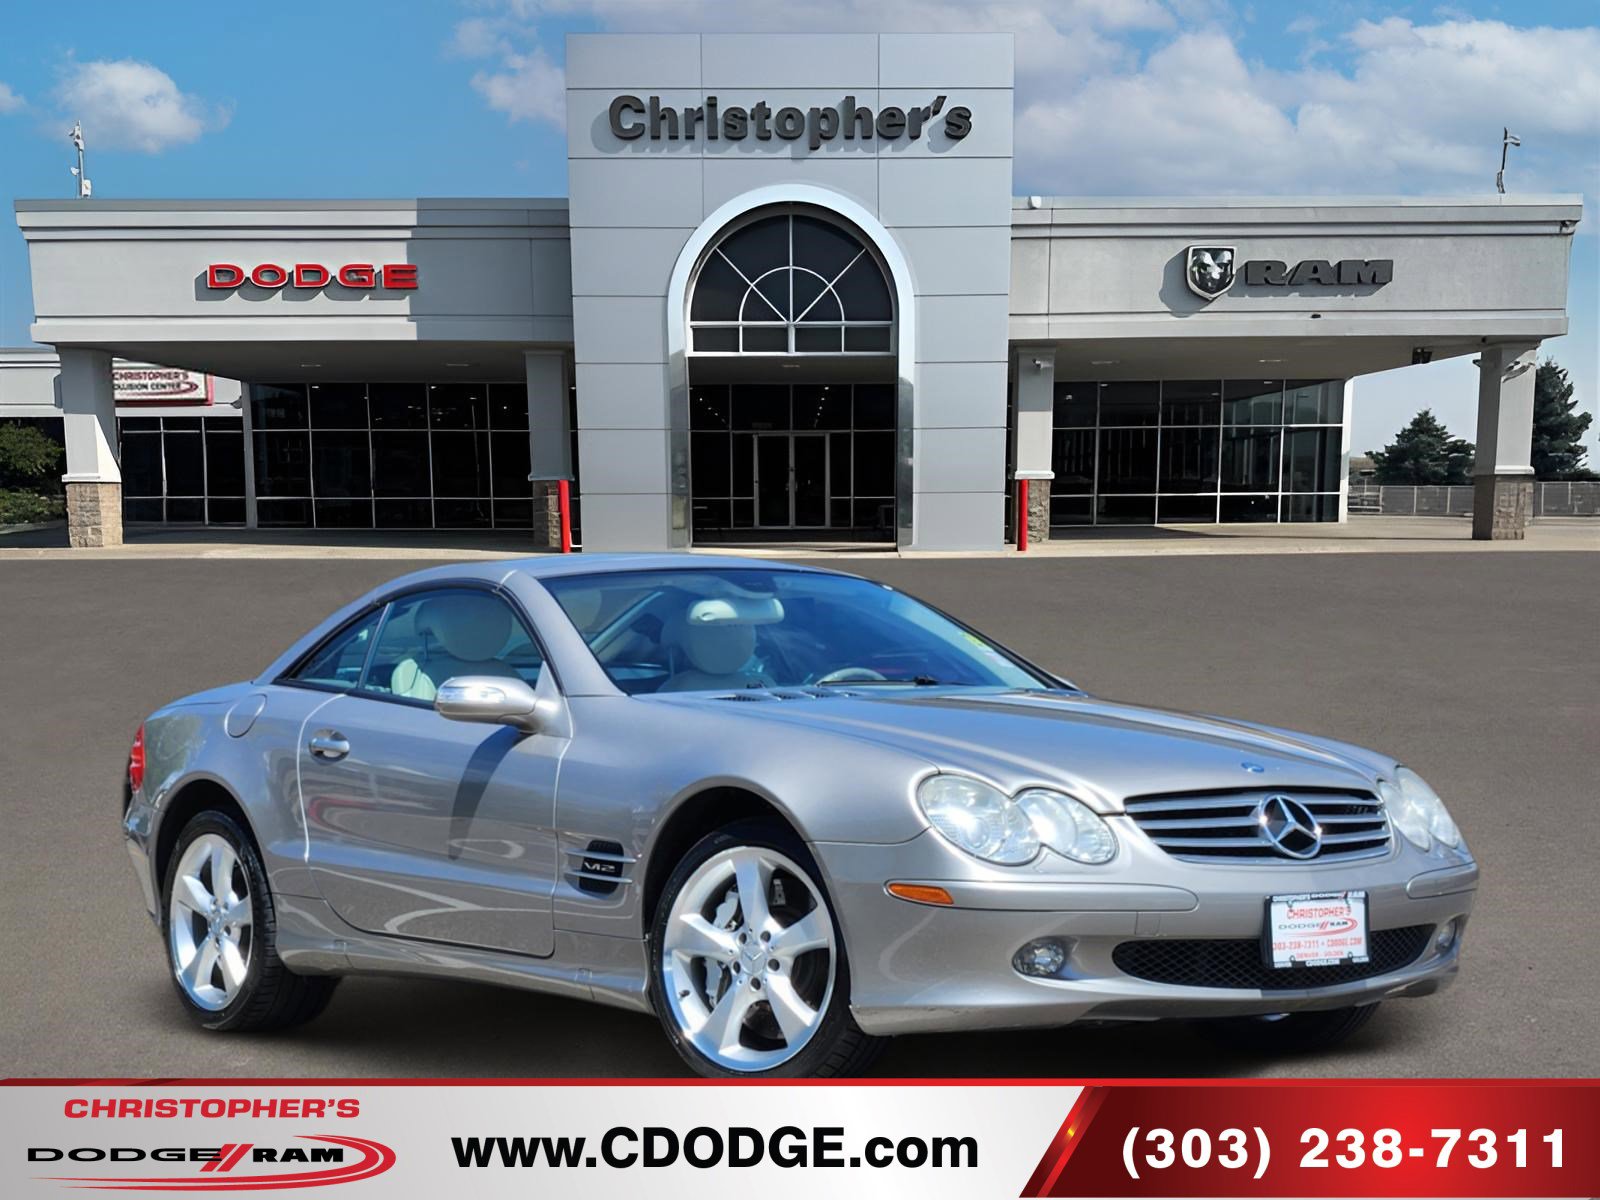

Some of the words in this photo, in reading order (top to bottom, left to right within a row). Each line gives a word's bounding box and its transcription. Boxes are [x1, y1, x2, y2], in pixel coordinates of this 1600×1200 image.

[609, 95, 973, 150] Christopher's
[206, 263, 418, 290] DODGE
[1245, 259, 1394, 285] RAM
[112, 382, 148, 391] OLLISION
[150, 382, 181, 391] CENTER
